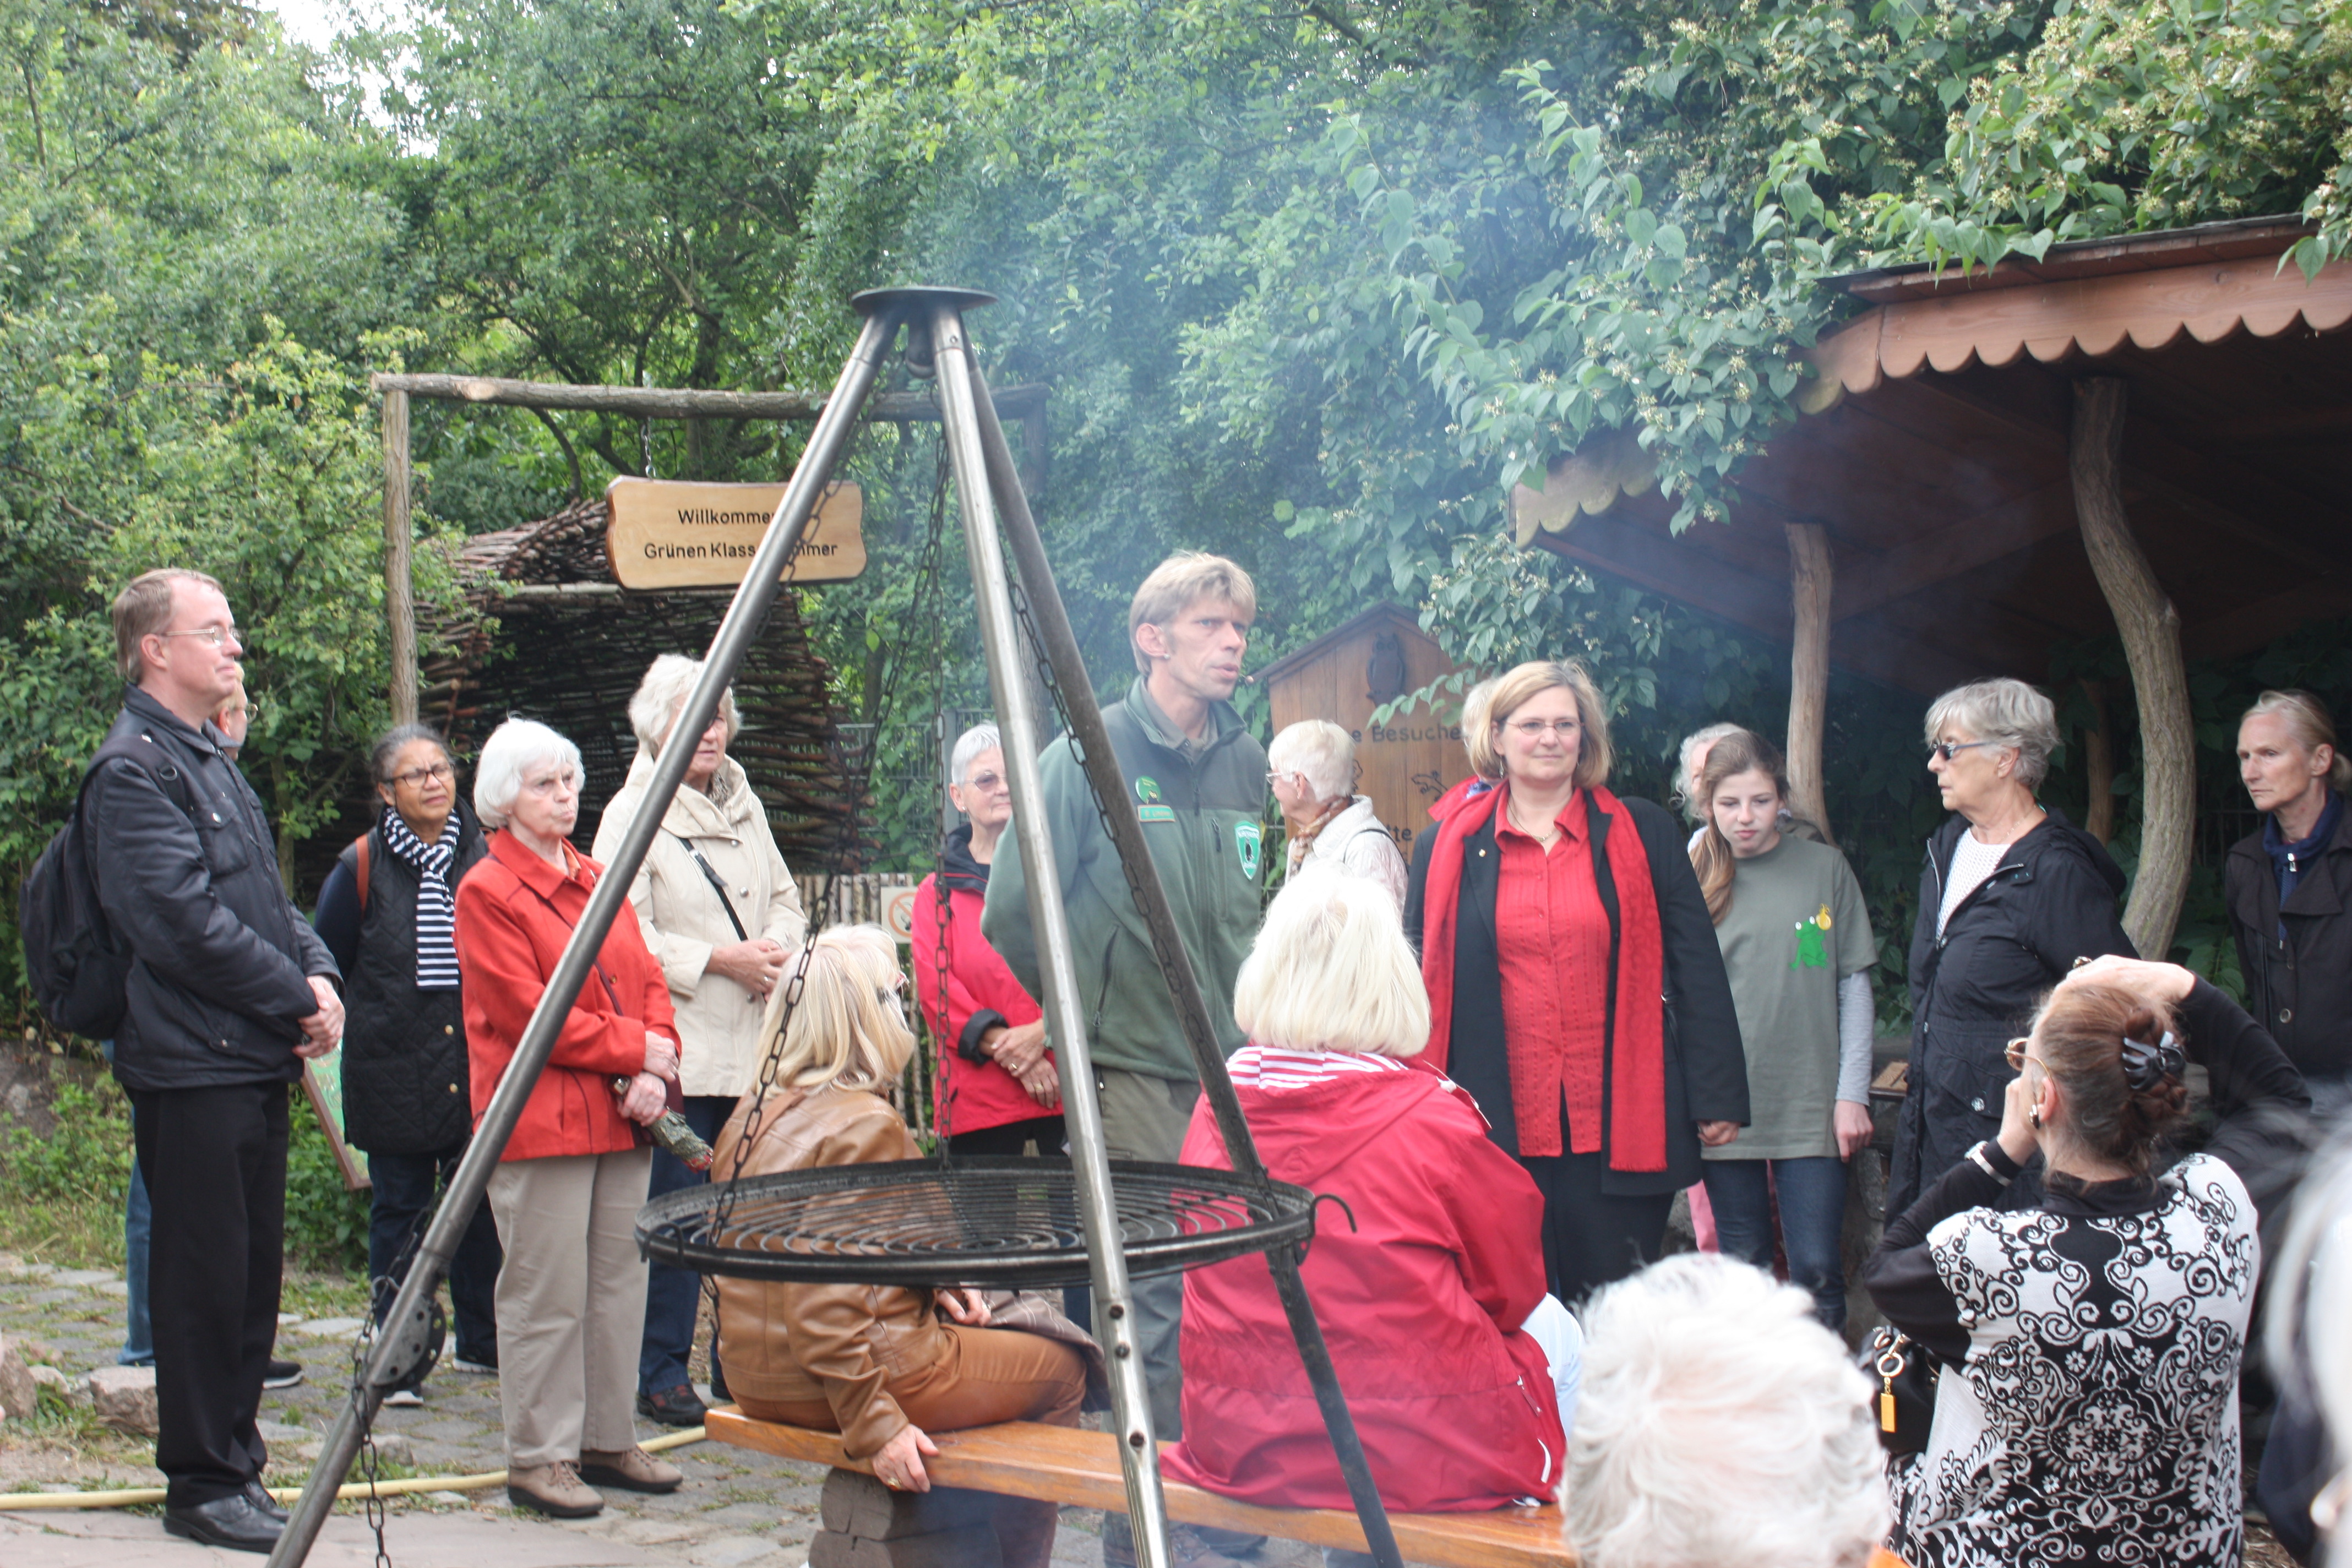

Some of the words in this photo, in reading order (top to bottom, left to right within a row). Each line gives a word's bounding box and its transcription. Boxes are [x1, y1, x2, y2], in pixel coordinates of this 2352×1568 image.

[678, 509, 775, 525] Willkomme
[644, 542, 706, 559] Grünen
[1372, 723, 1462, 743] Besuche
